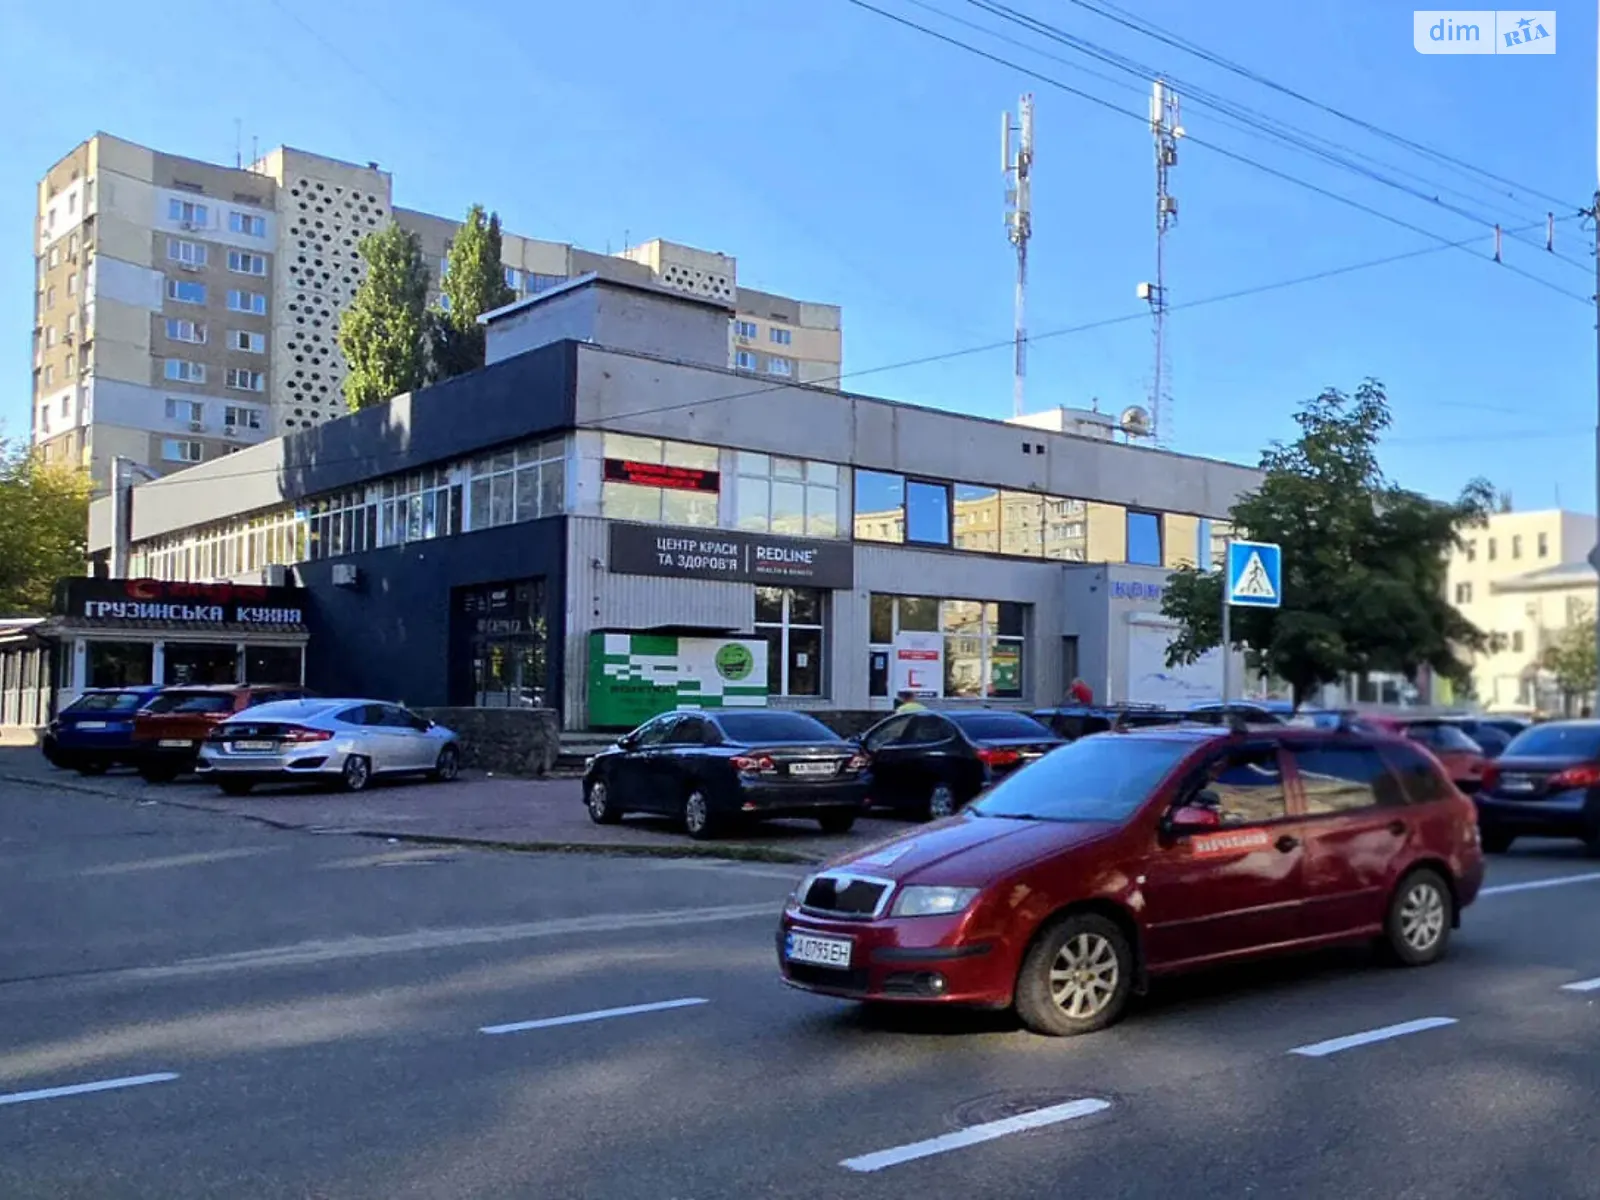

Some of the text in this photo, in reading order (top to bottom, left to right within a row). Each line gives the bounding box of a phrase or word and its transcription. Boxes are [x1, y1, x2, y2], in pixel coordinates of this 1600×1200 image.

[656, 537, 738, 556] ЦЕНТР КРАСИ
[756, 545, 813, 564] REDLINE
[658, 552, 673, 567] ТА
[84, 600, 302, 623] ГРУЗИНСЬКА КУХНЯ
